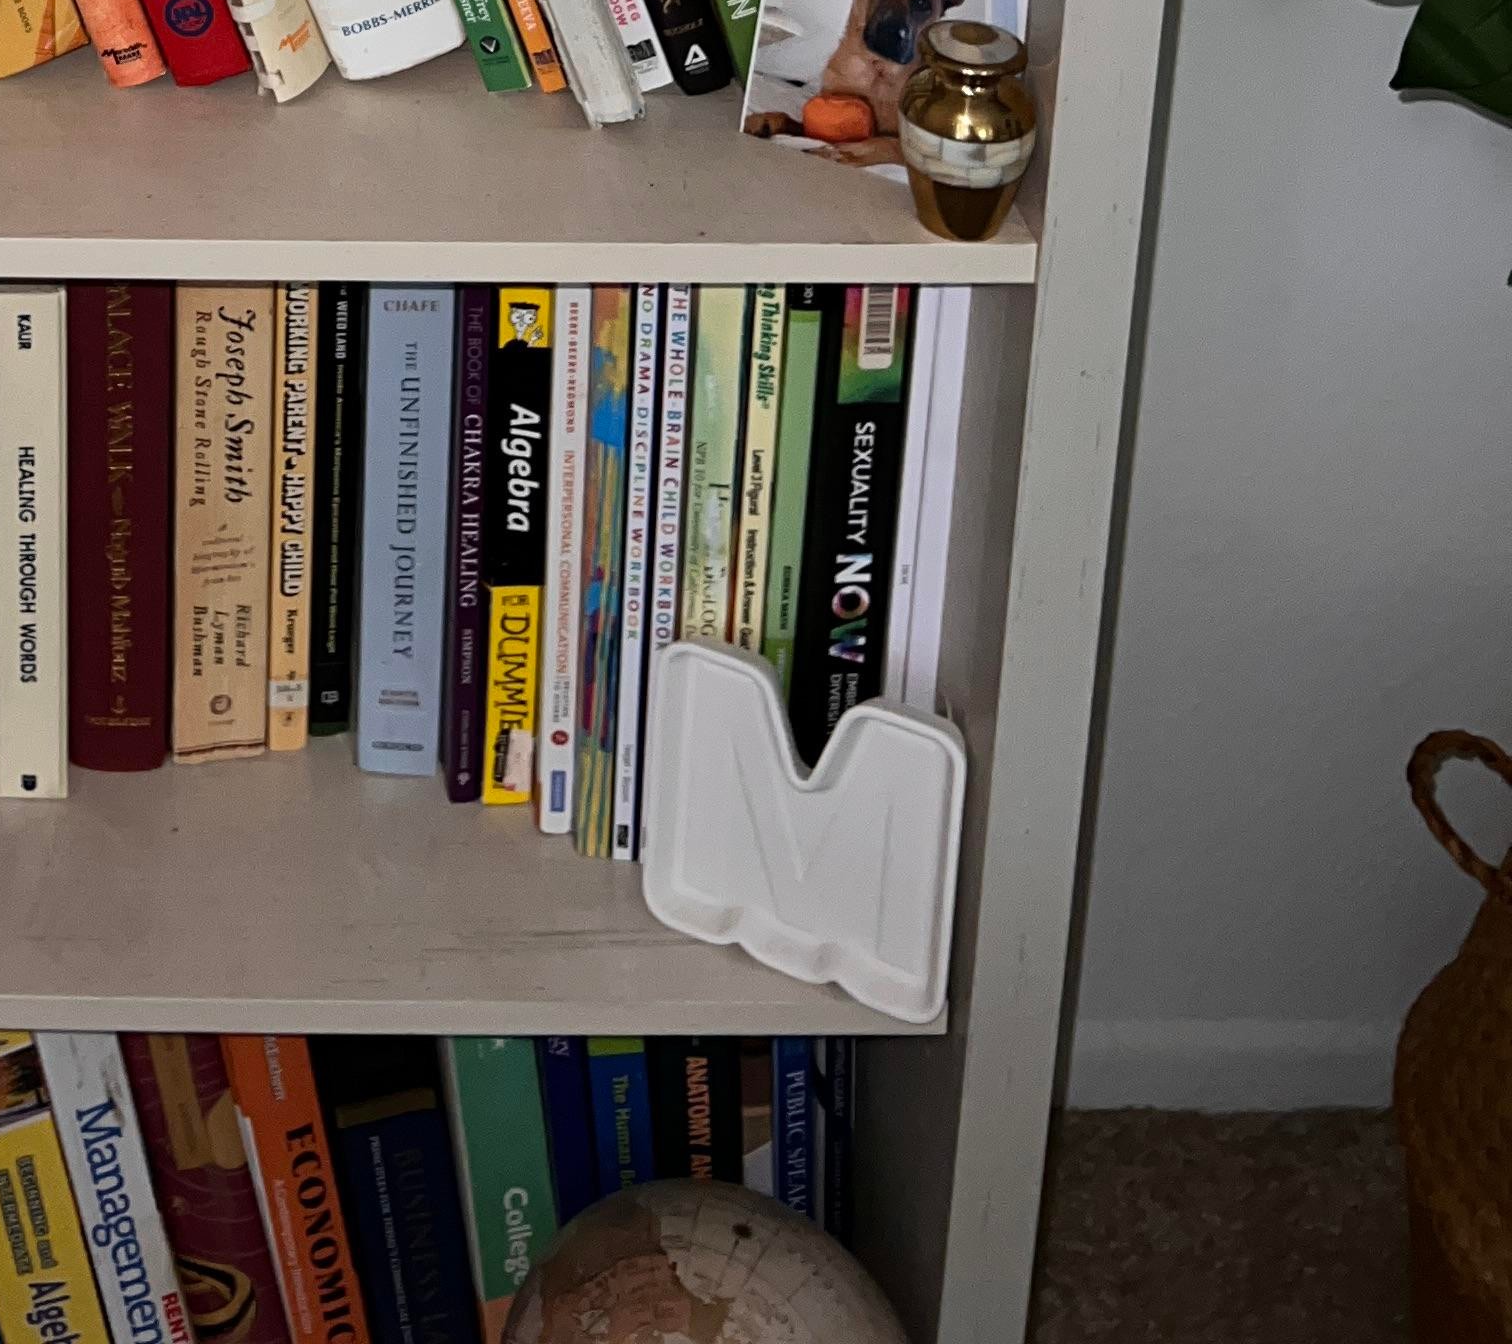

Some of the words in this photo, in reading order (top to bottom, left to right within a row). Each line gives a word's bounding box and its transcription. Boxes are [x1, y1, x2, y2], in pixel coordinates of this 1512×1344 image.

[16, 313, 33, 351] KAUR
[218, 305, 257, 403] Joseph
[17, 446, 37, 523] HEALING
[222, 413, 257, 504] Smith
[460, 413, 484, 506] CHAKRA
[499, 402, 543, 534] Algebra
[844, 420, 877, 546] SEXUALITY
[18, 534, 37, 613] THROUGH
[457, 511, 482, 609] HEALING
[19, 622, 37, 685] WORDS
[827, 552, 874, 664] NOW
[685, 1056, 712, 1147] ANATOMY
[786, 1069, 807, 1139] PUBLIC
[75, 1096, 165, 1344] Managemen
[286, 1126, 357, 1344] ECONOMIC
